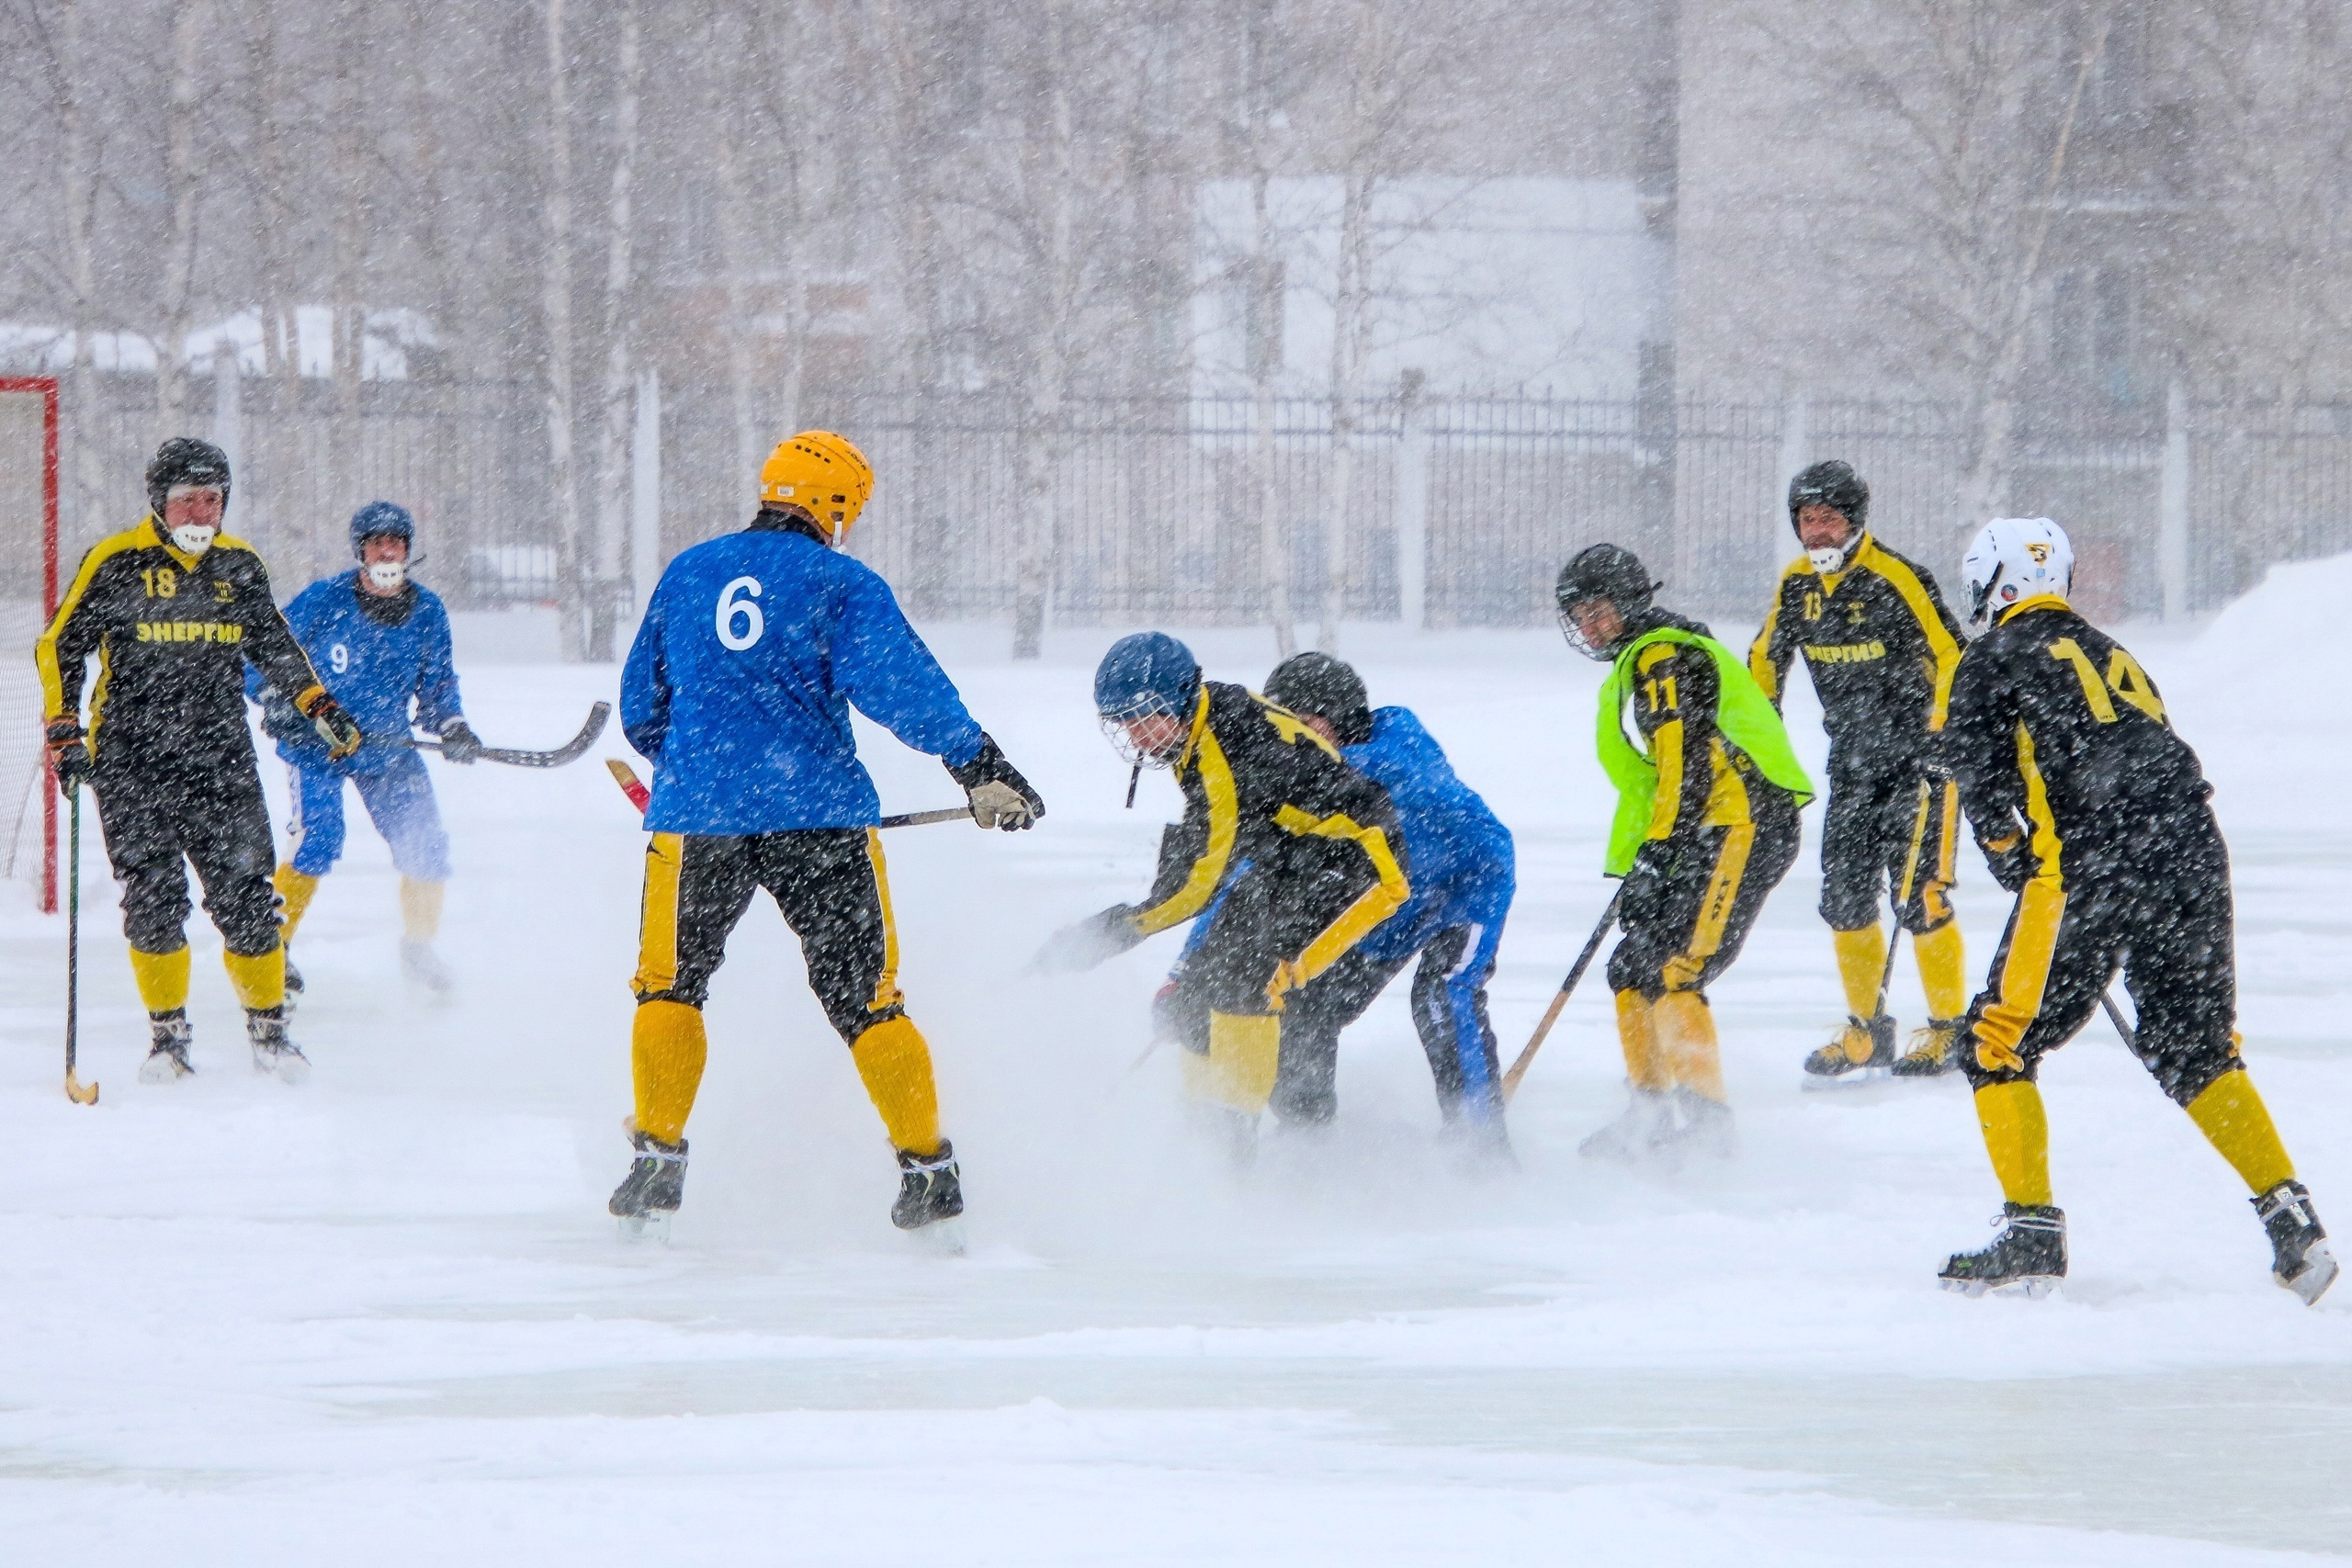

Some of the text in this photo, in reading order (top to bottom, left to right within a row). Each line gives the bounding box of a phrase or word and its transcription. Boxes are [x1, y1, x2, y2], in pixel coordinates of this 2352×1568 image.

[141, 568, 176, 599] 18
[716, 575, 764, 651] 6
[1804, 591, 1822, 621] 13
[136, 621, 243, 643] ЭНЕРГИЯ
[331, 643, 349, 674] 9
[1642, 675, 1679, 713] 11
[2048, 636, 2166, 725] 14
